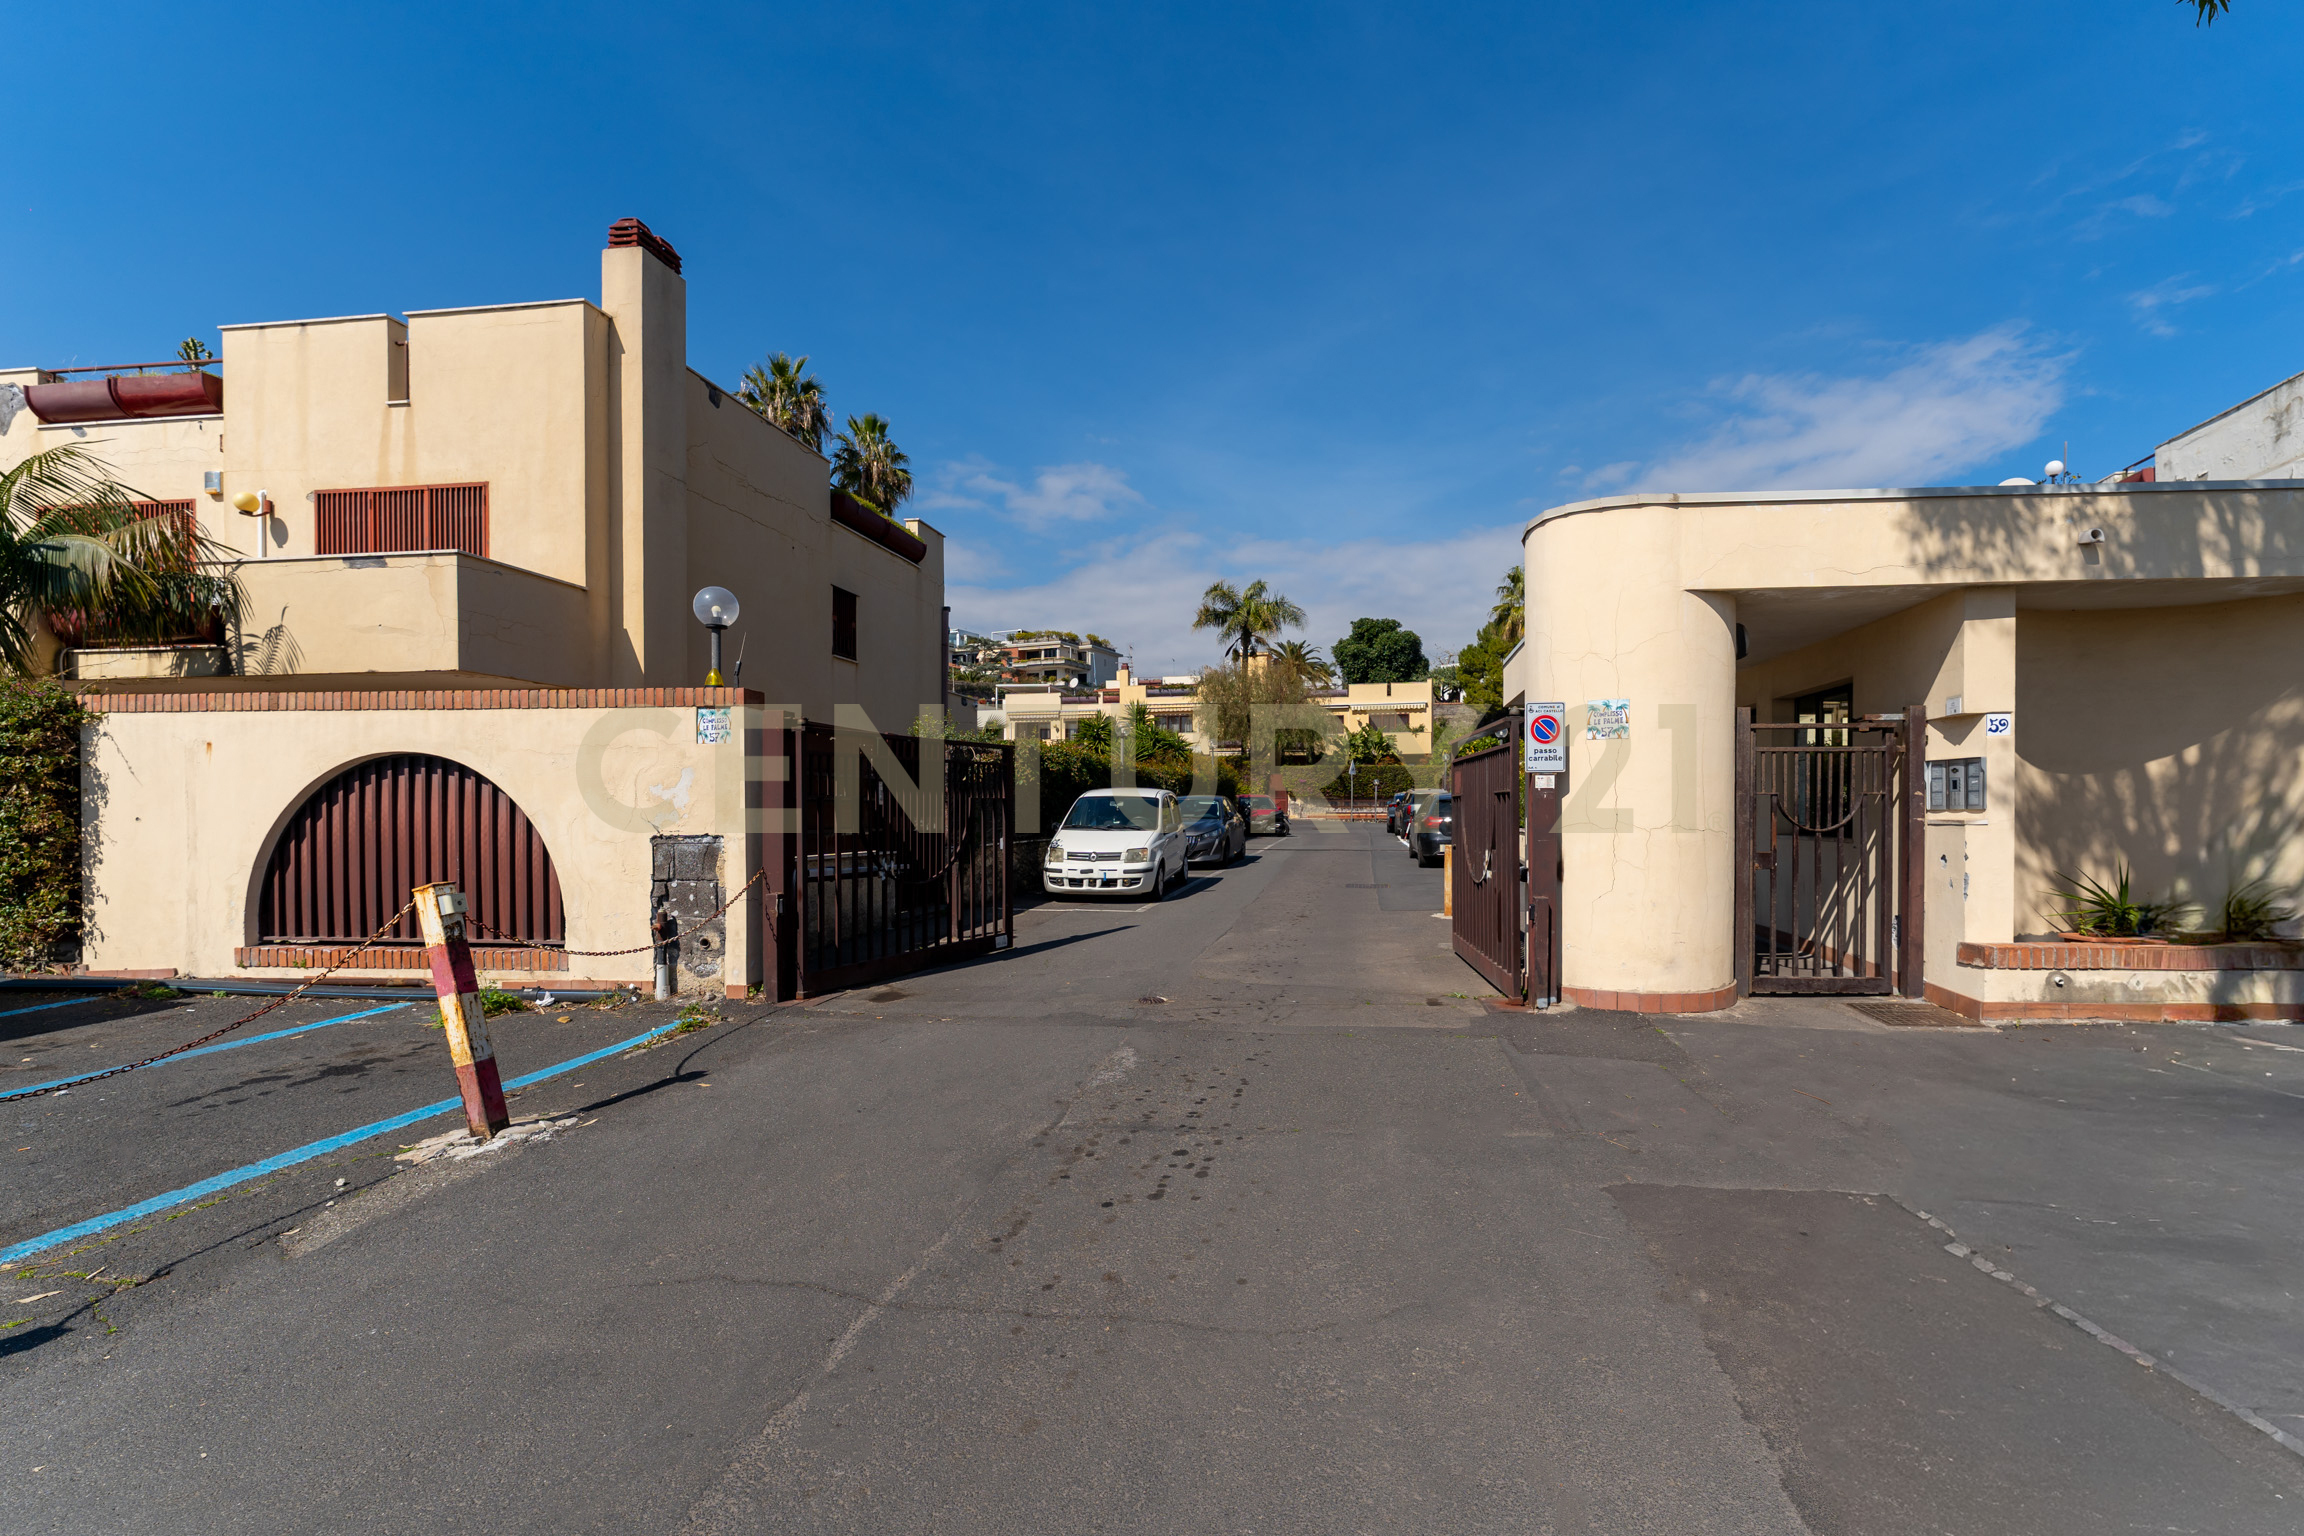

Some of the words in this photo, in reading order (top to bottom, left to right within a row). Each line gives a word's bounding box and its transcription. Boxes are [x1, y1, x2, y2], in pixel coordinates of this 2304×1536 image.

[1593, 718, 1601, 726] LE
[1603, 716, 1624, 725] PALME
[1988, 718, 2009, 733] 59
[709, 732, 720, 742] 57
[1601, 726, 1614, 738] 57
[1528, 754, 1563, 762] carrabile
